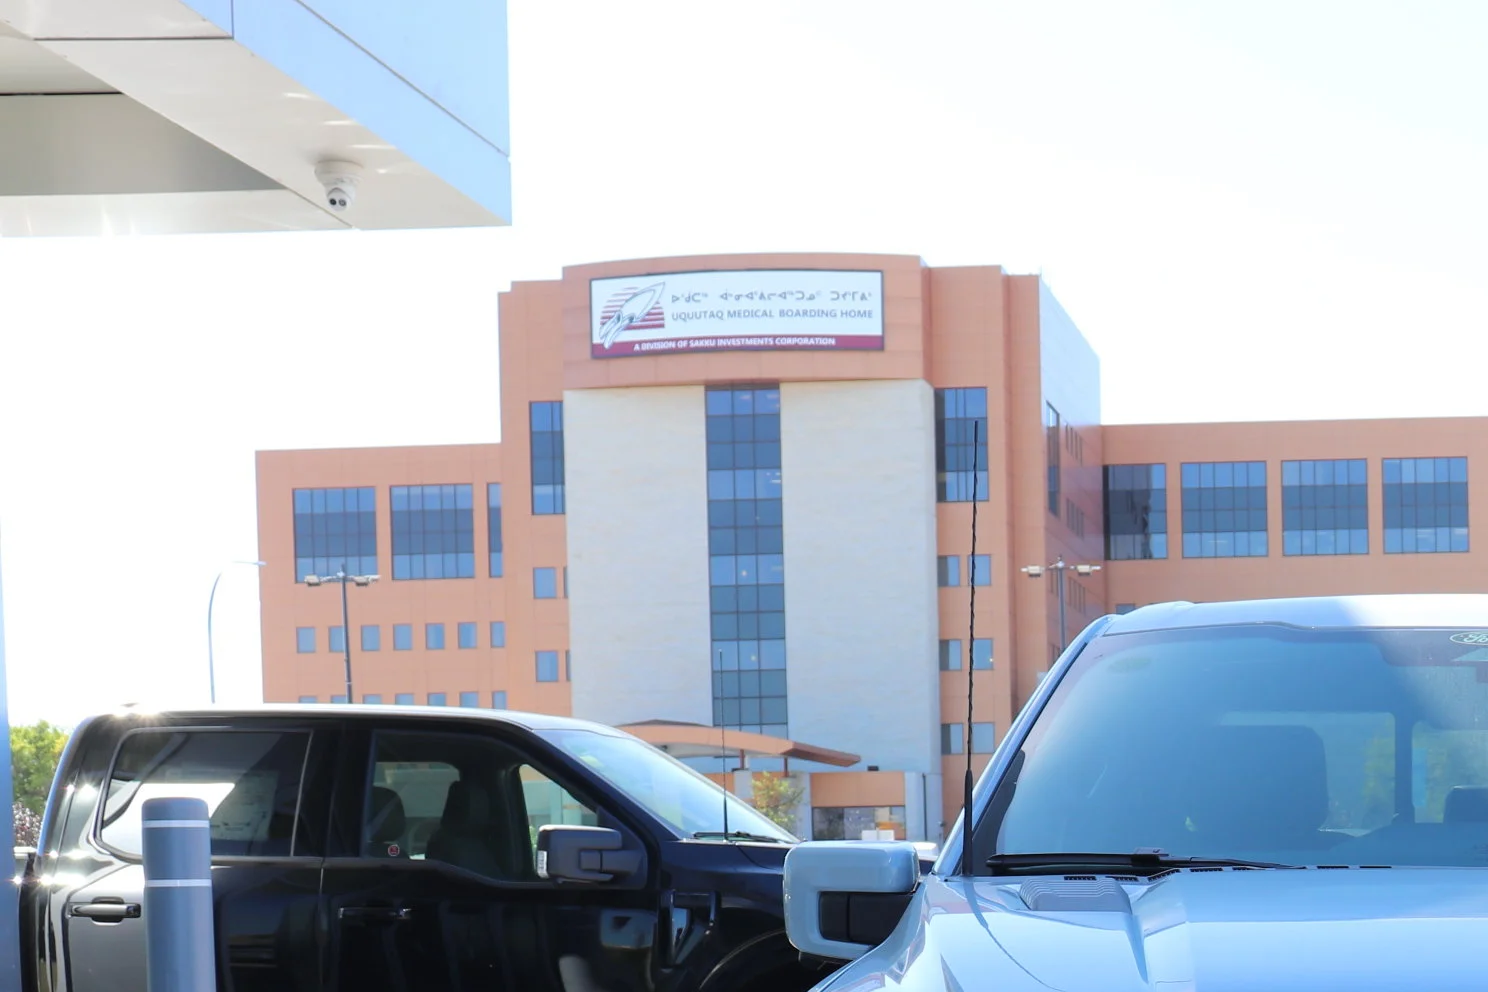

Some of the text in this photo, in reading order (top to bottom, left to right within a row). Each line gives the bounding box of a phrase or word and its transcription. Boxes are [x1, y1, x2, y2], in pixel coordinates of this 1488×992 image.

[671, 308, 873, 322] UQUUTAQ MEDICAL BOARDING HOME
[633, 343, 640, 351] A
[641, 340, 676, 350] DIVISION
[677, 340, 688, 348] OF
[717, 337, 774, 347] INVESTMENTS
[775, 336, 837, 346] CORPORATION
